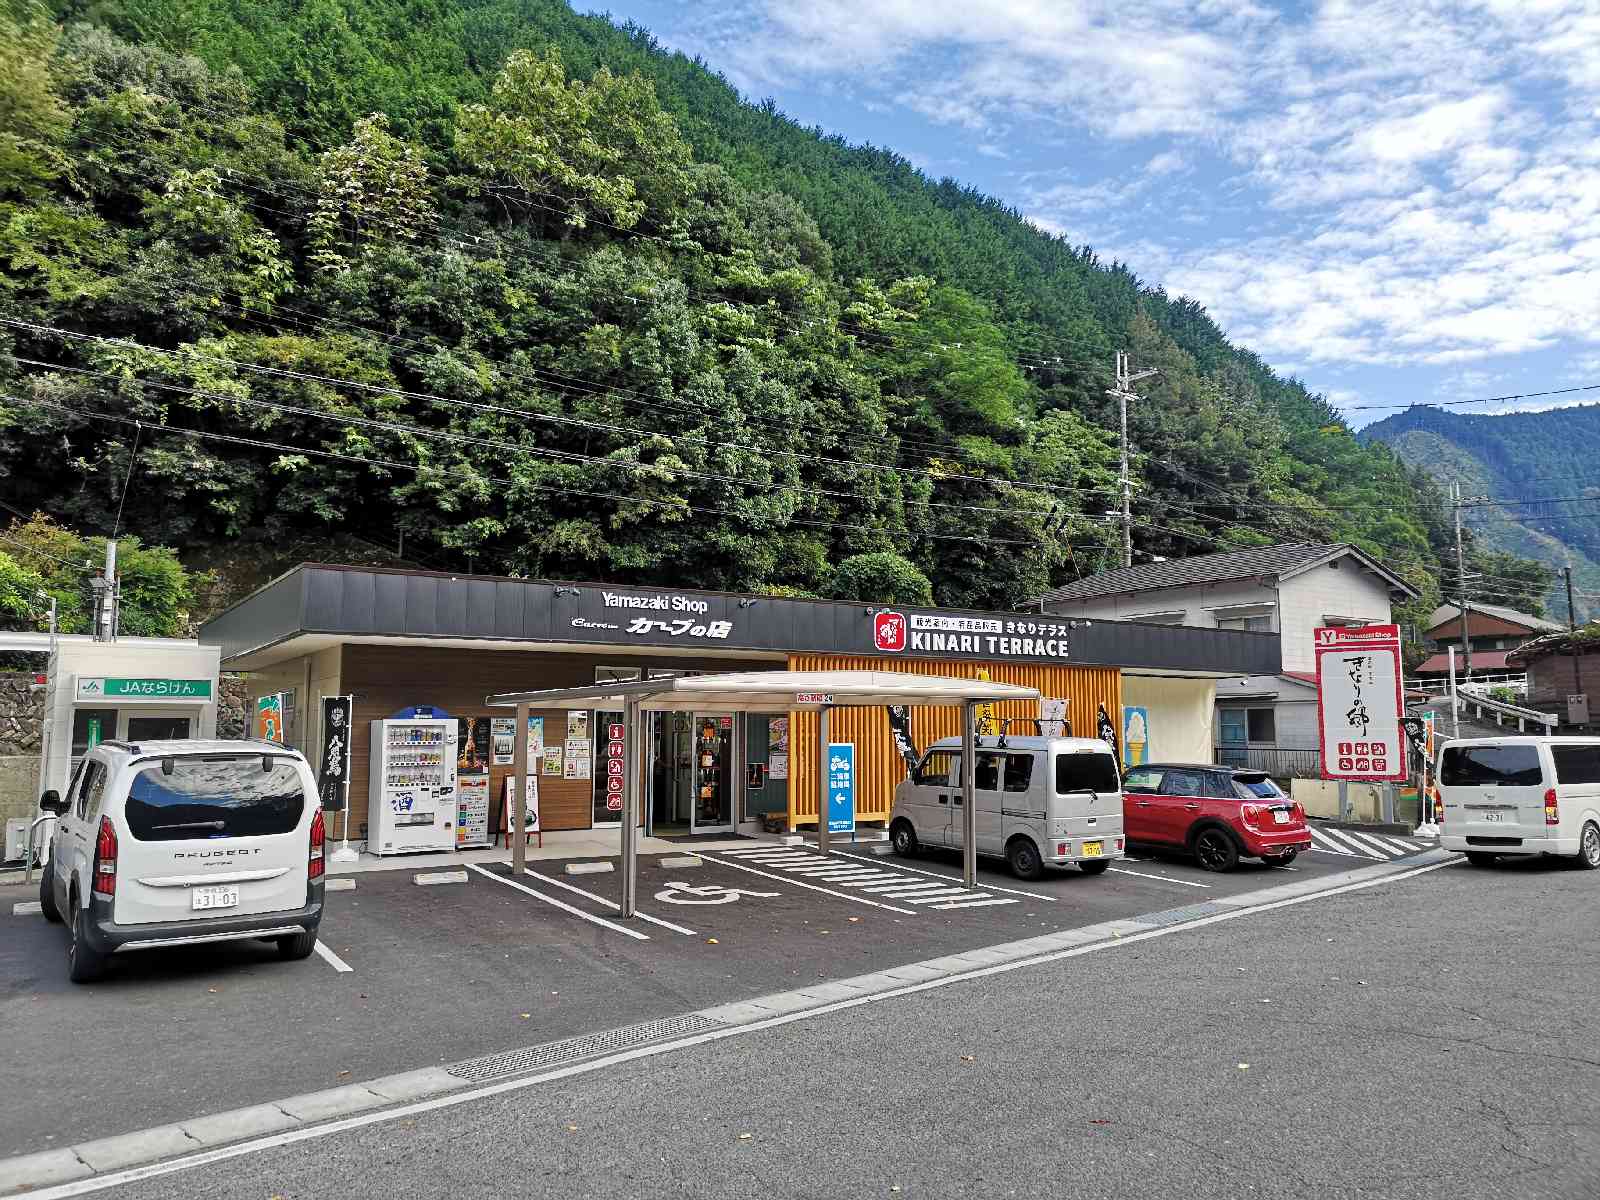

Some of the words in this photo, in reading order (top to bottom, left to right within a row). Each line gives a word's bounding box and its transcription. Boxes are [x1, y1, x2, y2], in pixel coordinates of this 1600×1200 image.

[602, 591, 668, 610] Yamazaki
[672, 596, 708, 614] Shop
[1006, 621, 1068, 637] きなりテラス
[911, 631, 980, 653] KINARI
[984, 636, 1069, 657] TERRACE
[119, 681, 196, 695] JAならけん
